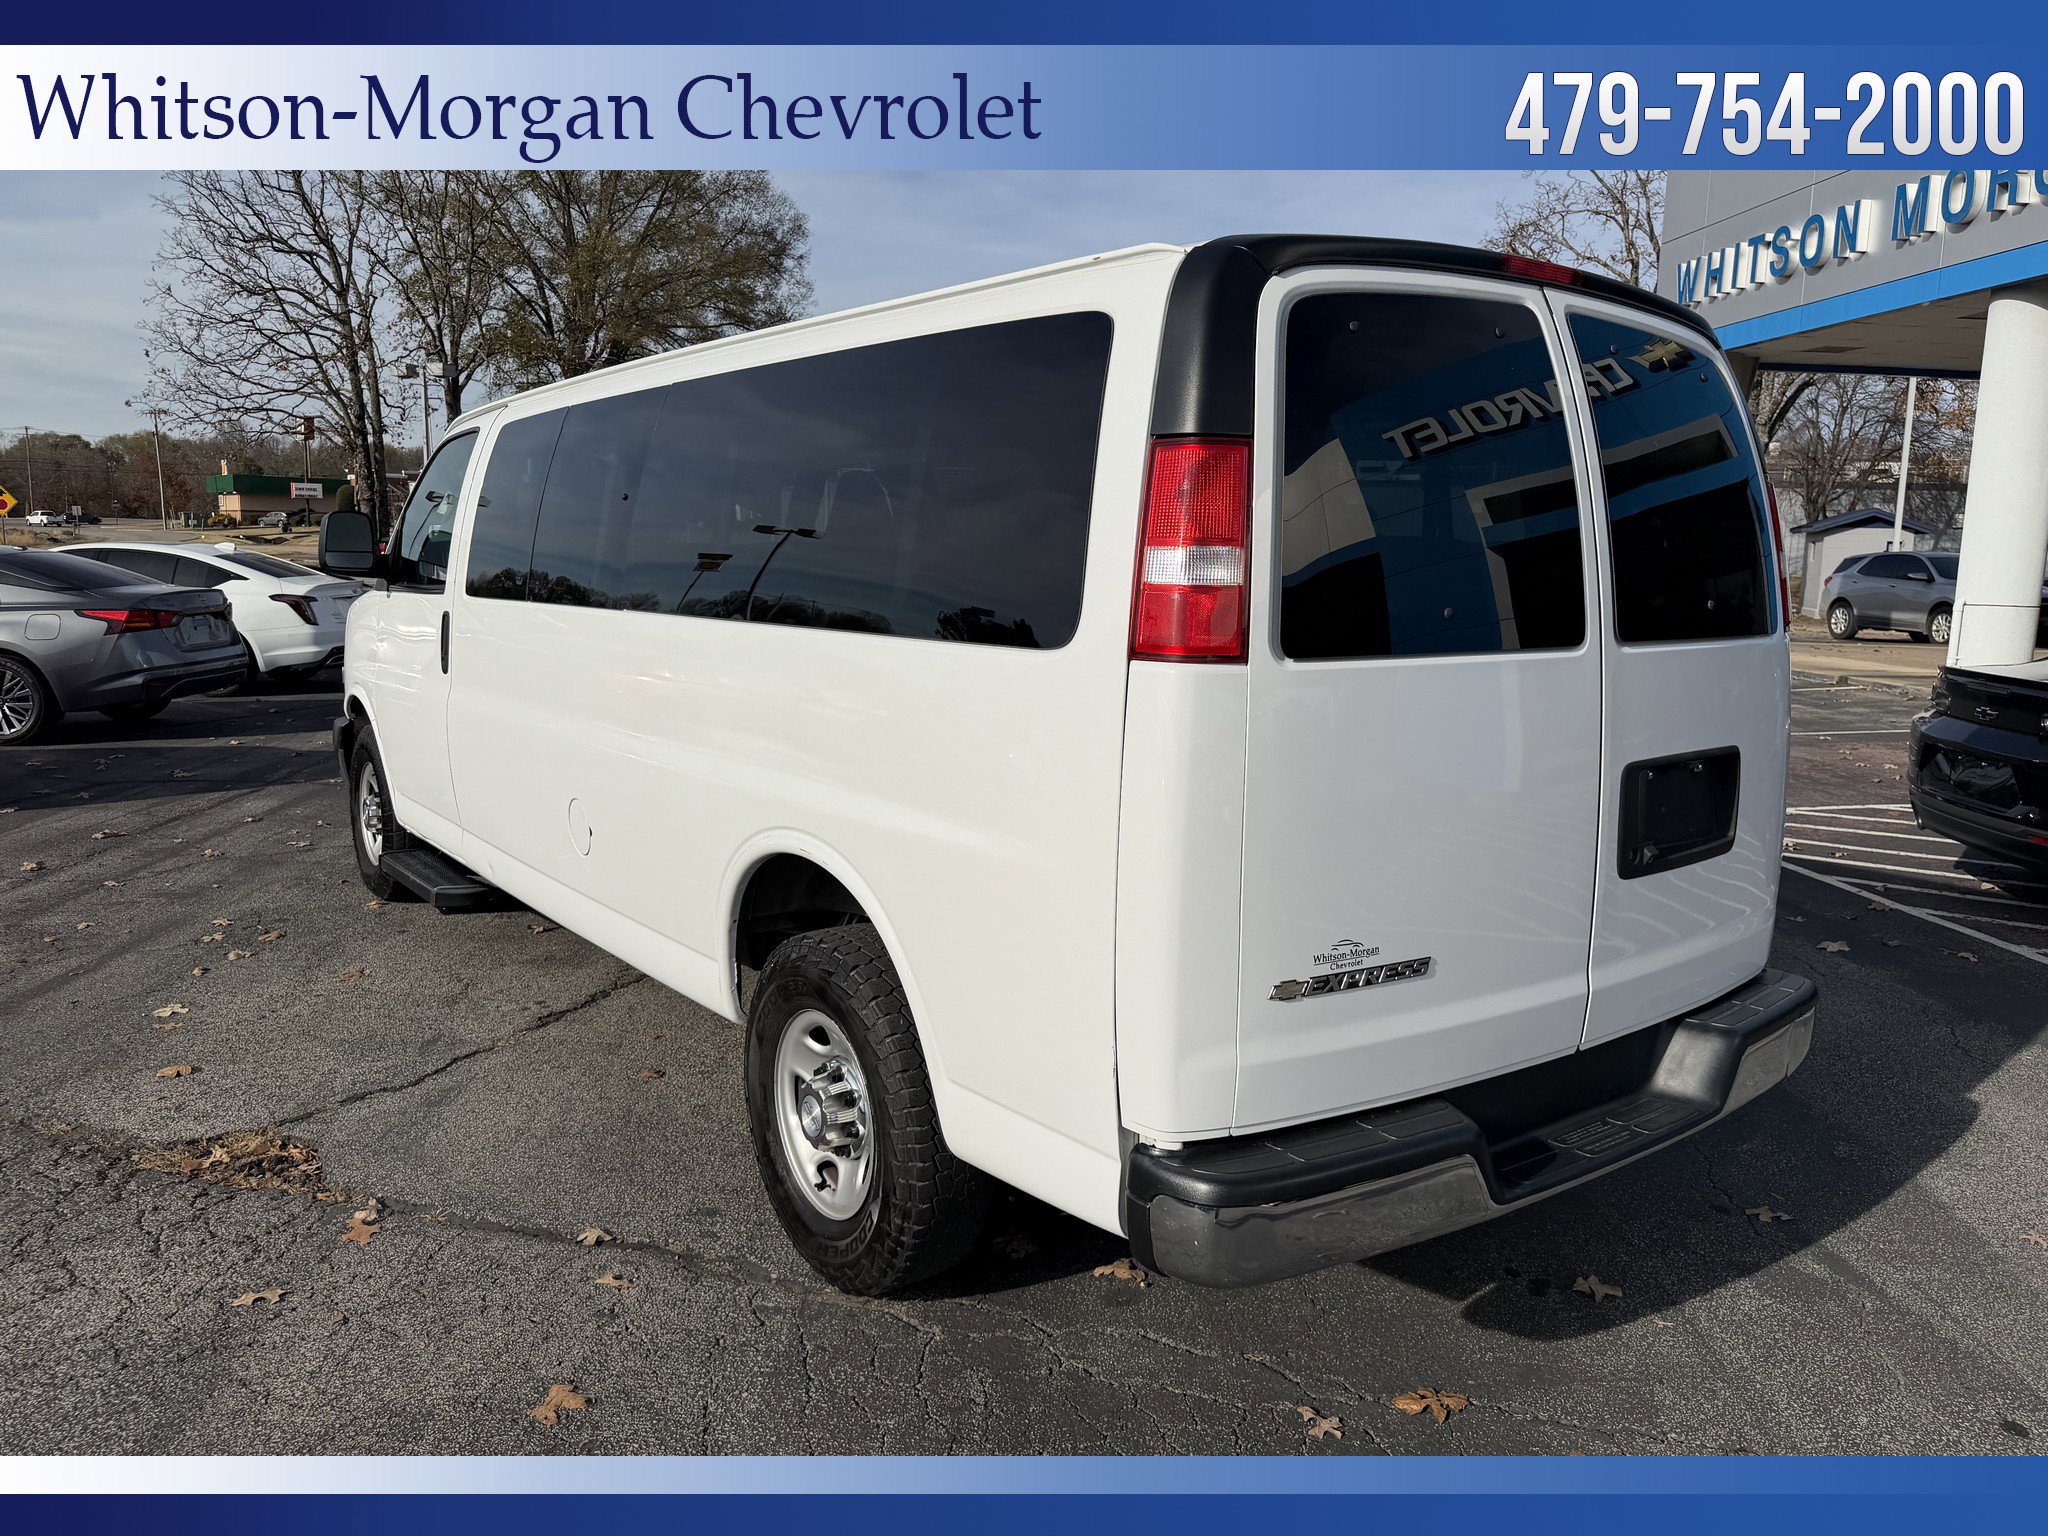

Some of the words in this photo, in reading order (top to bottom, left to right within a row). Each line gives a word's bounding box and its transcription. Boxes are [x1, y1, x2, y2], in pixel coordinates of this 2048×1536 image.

[1677, 199, 1866, 305] WHITSON
[1892, 170, 2048, 241] MOR
[1313, 946, 1380, 964] Whitson-Morgan
[1330, 958, 1364, 971] Chevrolet
[1305, 957, 1432, 996] EXPRESS
